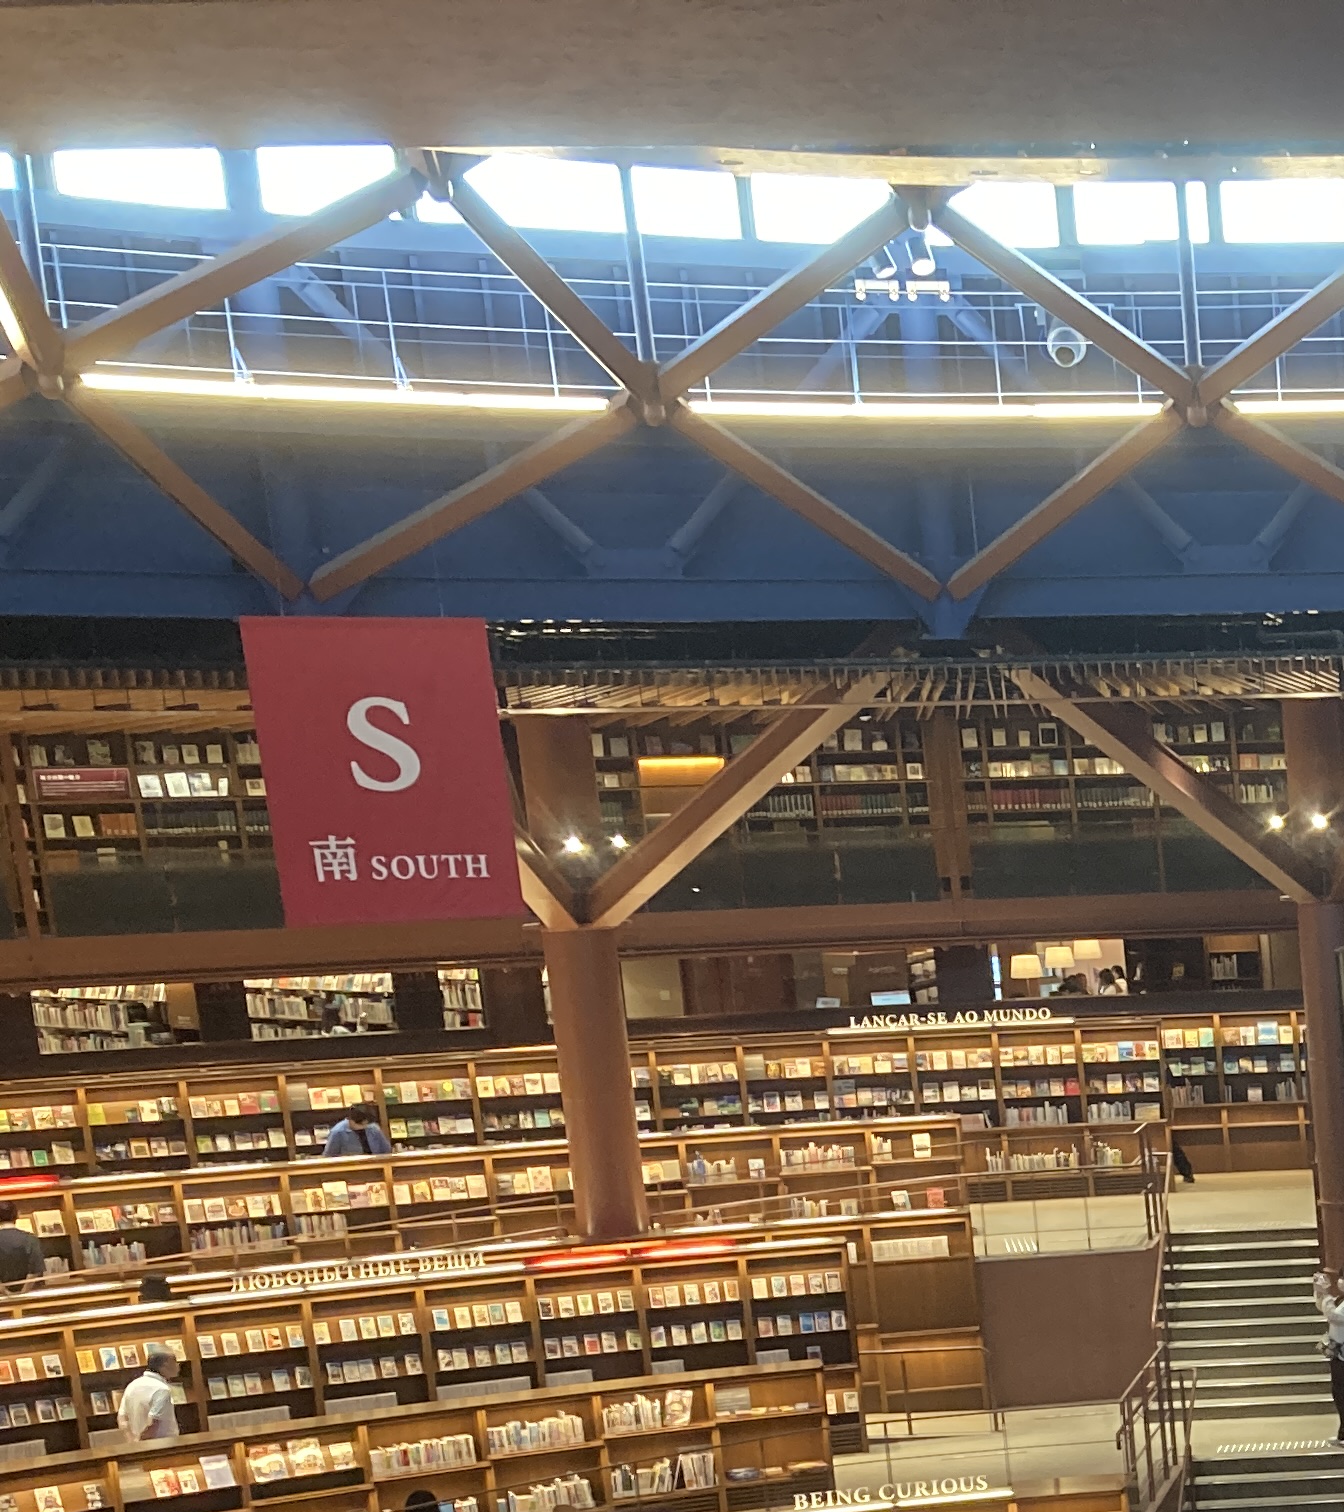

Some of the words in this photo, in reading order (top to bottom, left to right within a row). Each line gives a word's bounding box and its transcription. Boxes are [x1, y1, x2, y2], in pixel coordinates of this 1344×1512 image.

[347, 697, 420, 792] S
[309, 835, 358, 882] 南
[371, 854, 491, 880] SOUTH
[850, 1012, 948, 1030] LANÇAR-SE
[953, 1010, 978, 1024] AO
[984, 1007, 1051, 1023] MUNDO
[418, 1252, 486, 1273] ВЕЩИ
[793, 1486, 871, 1511] BEING
[878, 1475, 988, 1501] CURIOUS
